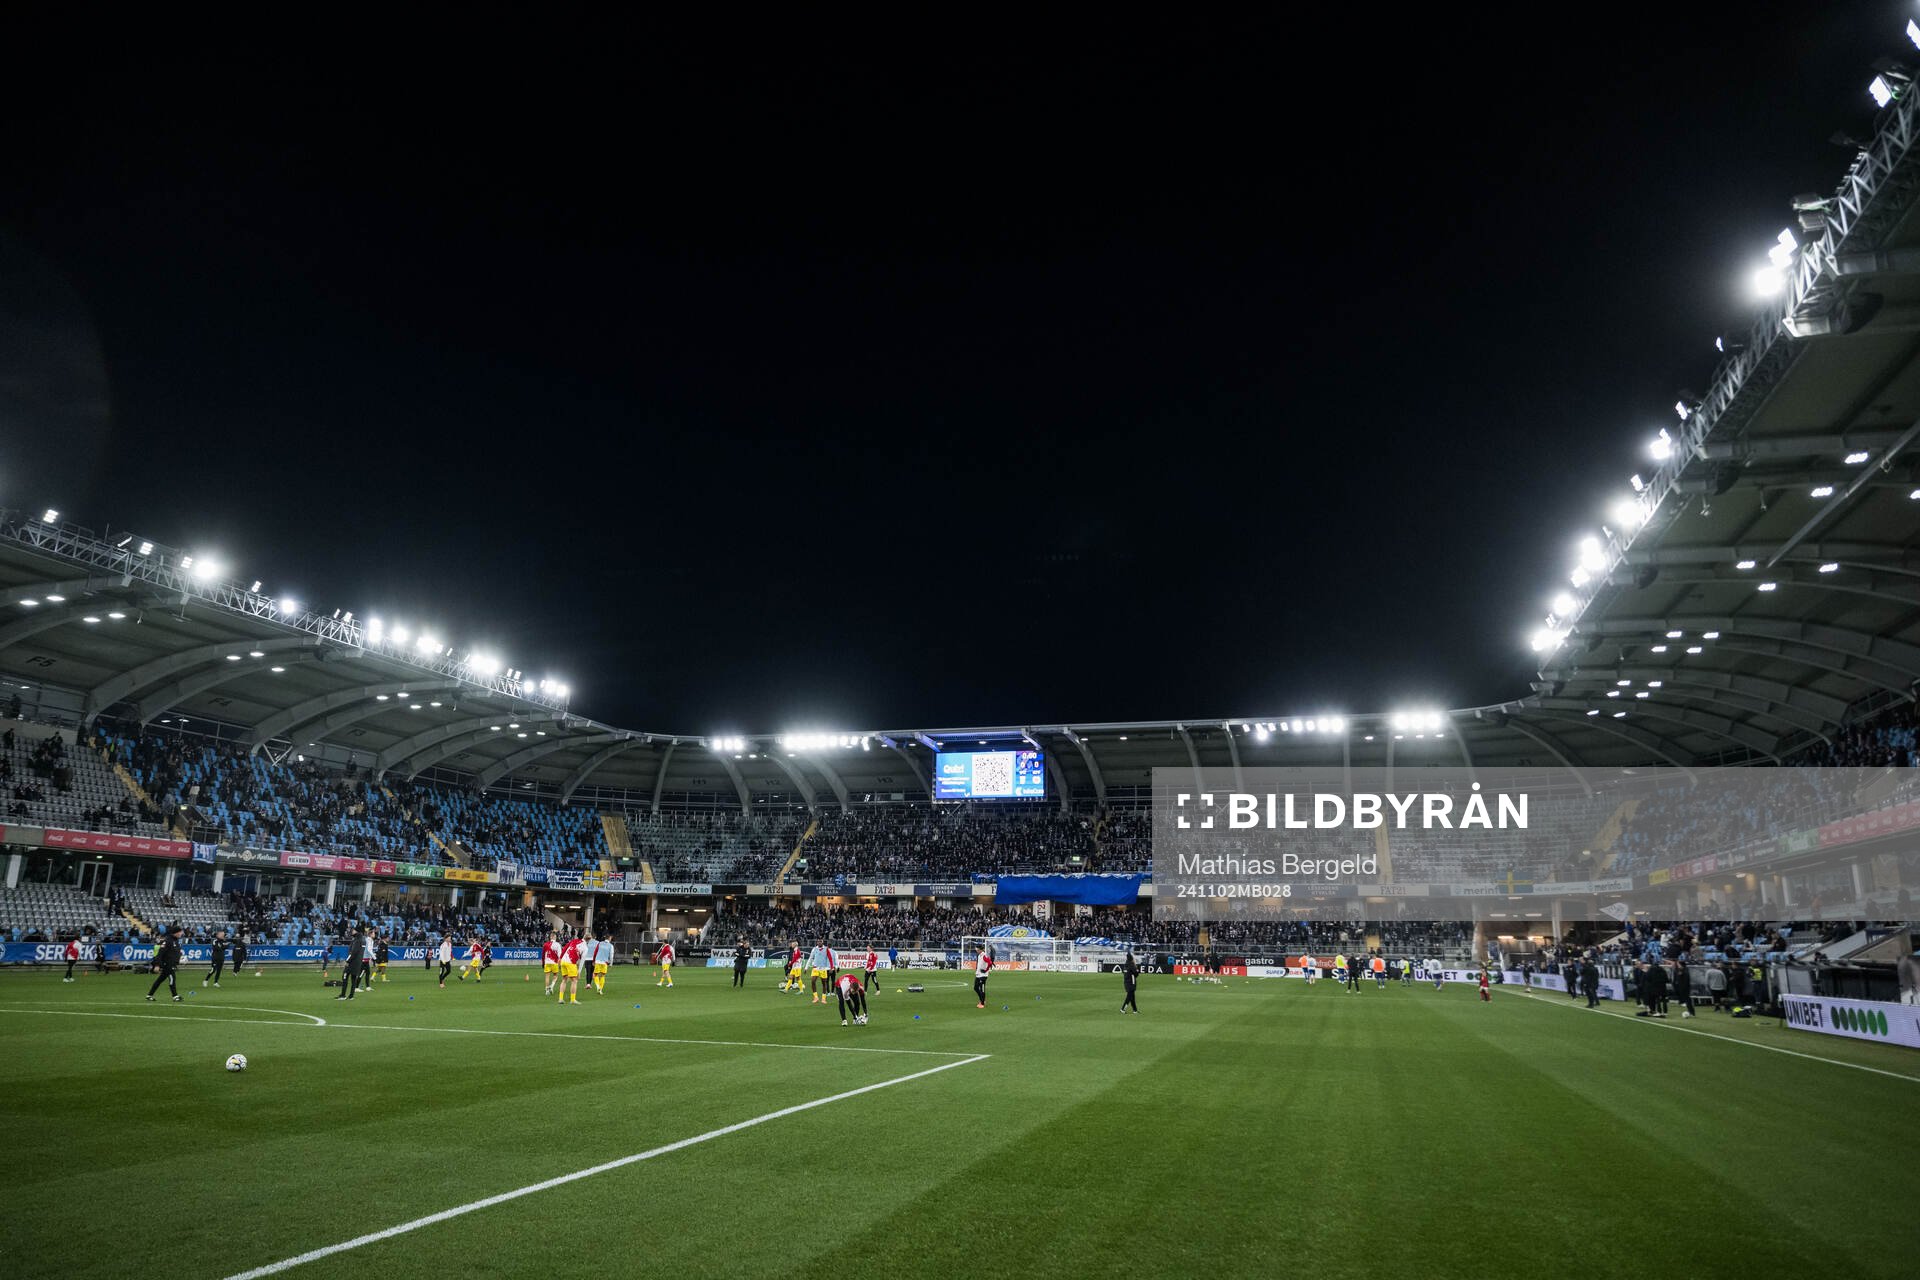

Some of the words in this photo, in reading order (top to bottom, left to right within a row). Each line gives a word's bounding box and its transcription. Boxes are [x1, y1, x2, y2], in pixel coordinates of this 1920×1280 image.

[764, 886, 783, 894] FAT21
[874, 886, 895, 894] FAT21
[1380, 886, 1407, 895] FAT21
[35, 944, 98, 961] SEREK
[403, 949, 425, 960] AROS
[513, 950, 539, 958] GÖTEBORG
[1168, 956, 1199, 966] Brixo
[1182, 967, 1238, 975] BAUUS
[1416, 971, 1457, 979] UNET
[1784, 1000, 1824, 1027] UNIBET
